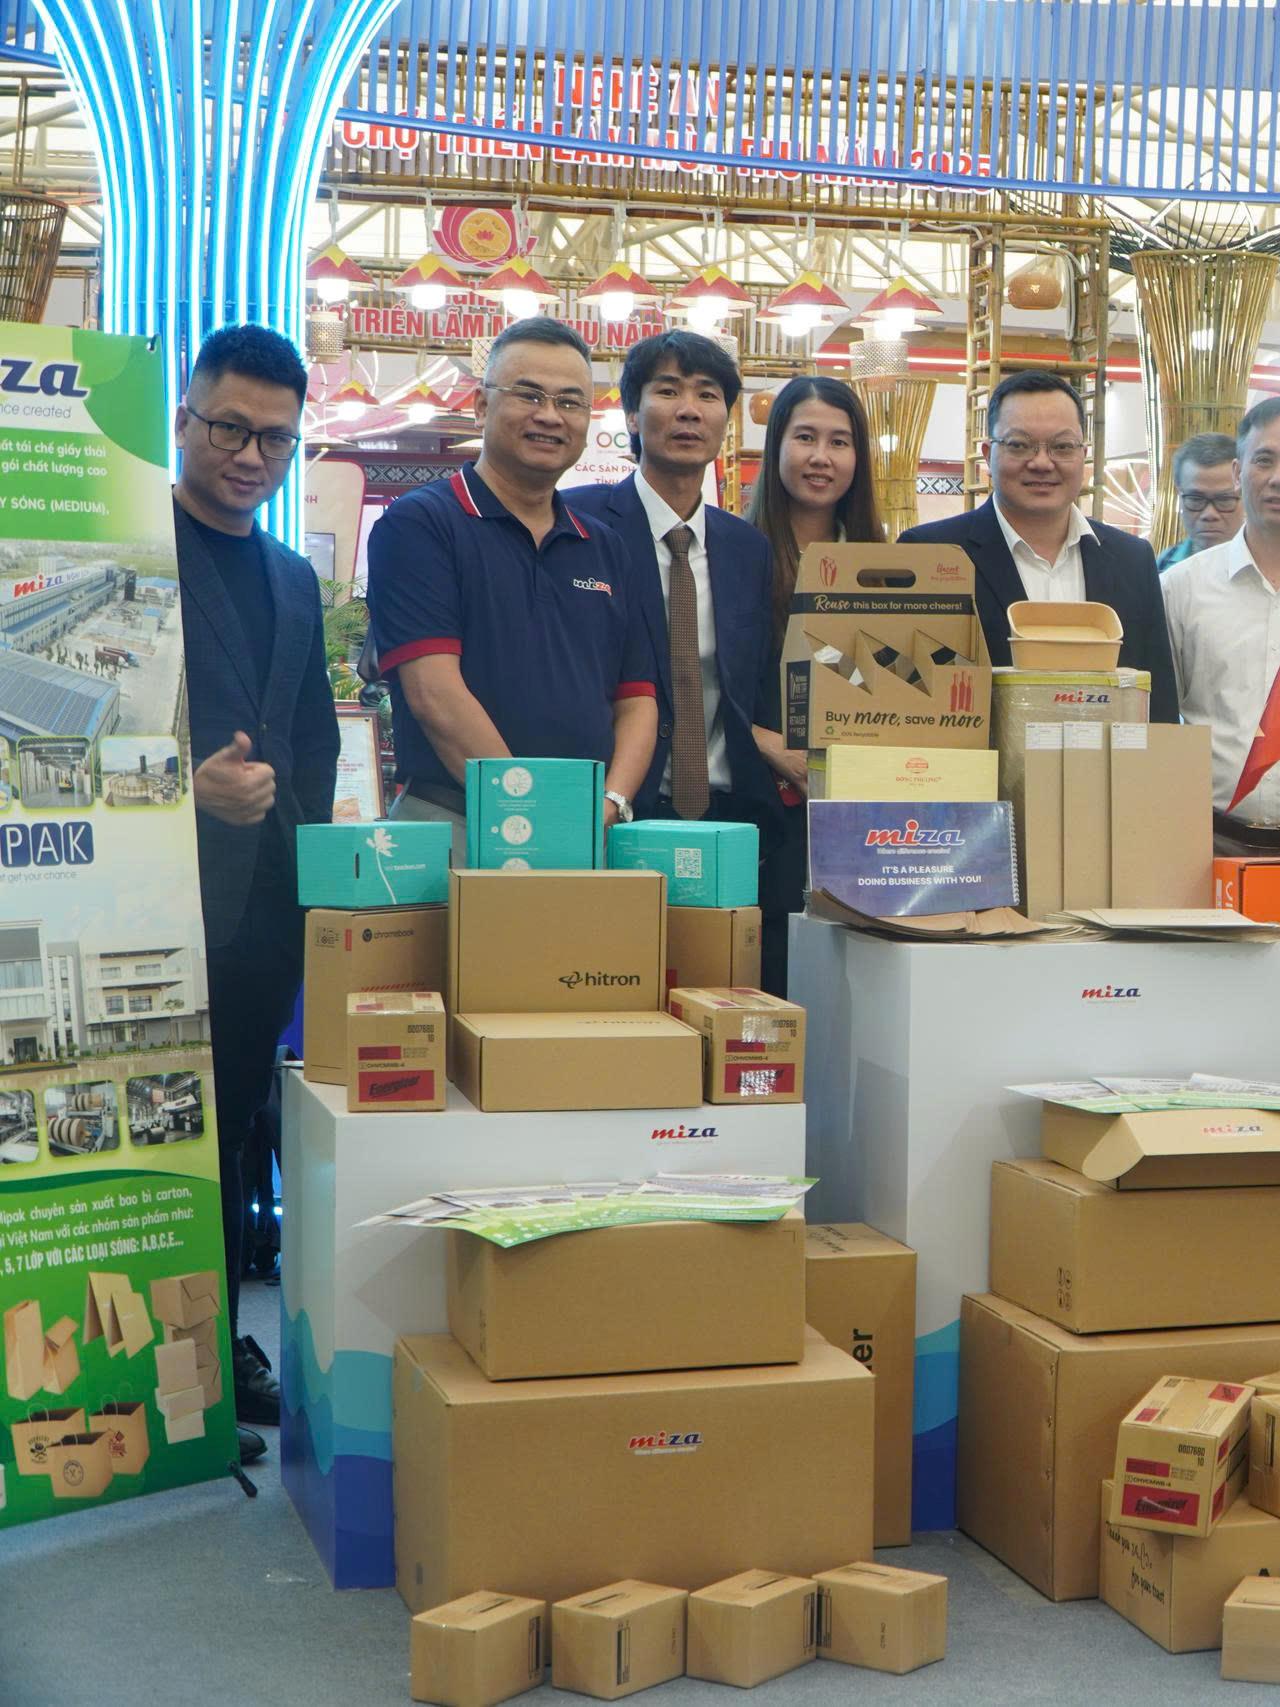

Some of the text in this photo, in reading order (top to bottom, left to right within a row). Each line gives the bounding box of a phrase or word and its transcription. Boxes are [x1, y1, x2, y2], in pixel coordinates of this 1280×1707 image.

[351, 299, 425, 337] TRIỂN
[431, 307, 484, 339] LÃM
[23, 404, 71, 419] created
[16, 441, 32, 452] tái
[34, 442, 55, 454] chế
[57, 443, 82, 458] giấy
[23, 460, 49, 473] chất
[51, 462, 84, 477] lượng
[87, 466, 108, 477] cao
[575, 462, 595, 472] CÁC
[11, 495, 46, 510] SÓNG
[814, 594, 962, 611] Reuse this box for more cheers!
[1053, 690, 1111, 705] miza
[825, 711, 850, 725] Buy
[905, 714, 935, 725] save
[939, 713, 984, 728] more
[864, 819, 965, 846] miza
[882, 865, 955, 874] IT'S A PLEASURE
[858, 875, 982, 886] DOING BUSINESS WITH YOU!
[585, 972, 640, 986] hitron
[1081, 985, 1142, 999] miza
[651, 1125, 719, 1140] miza
[1203, 1123, 1263, 1135] miza
[119, 1194, 138, 1207] bao
[7, 1232, 27, 1248] Việt
[30, 1229, 53, 1243] Nam
[64, 1243, 84, 1264] CÁC
[628, 1430, 703, 1450] miza
